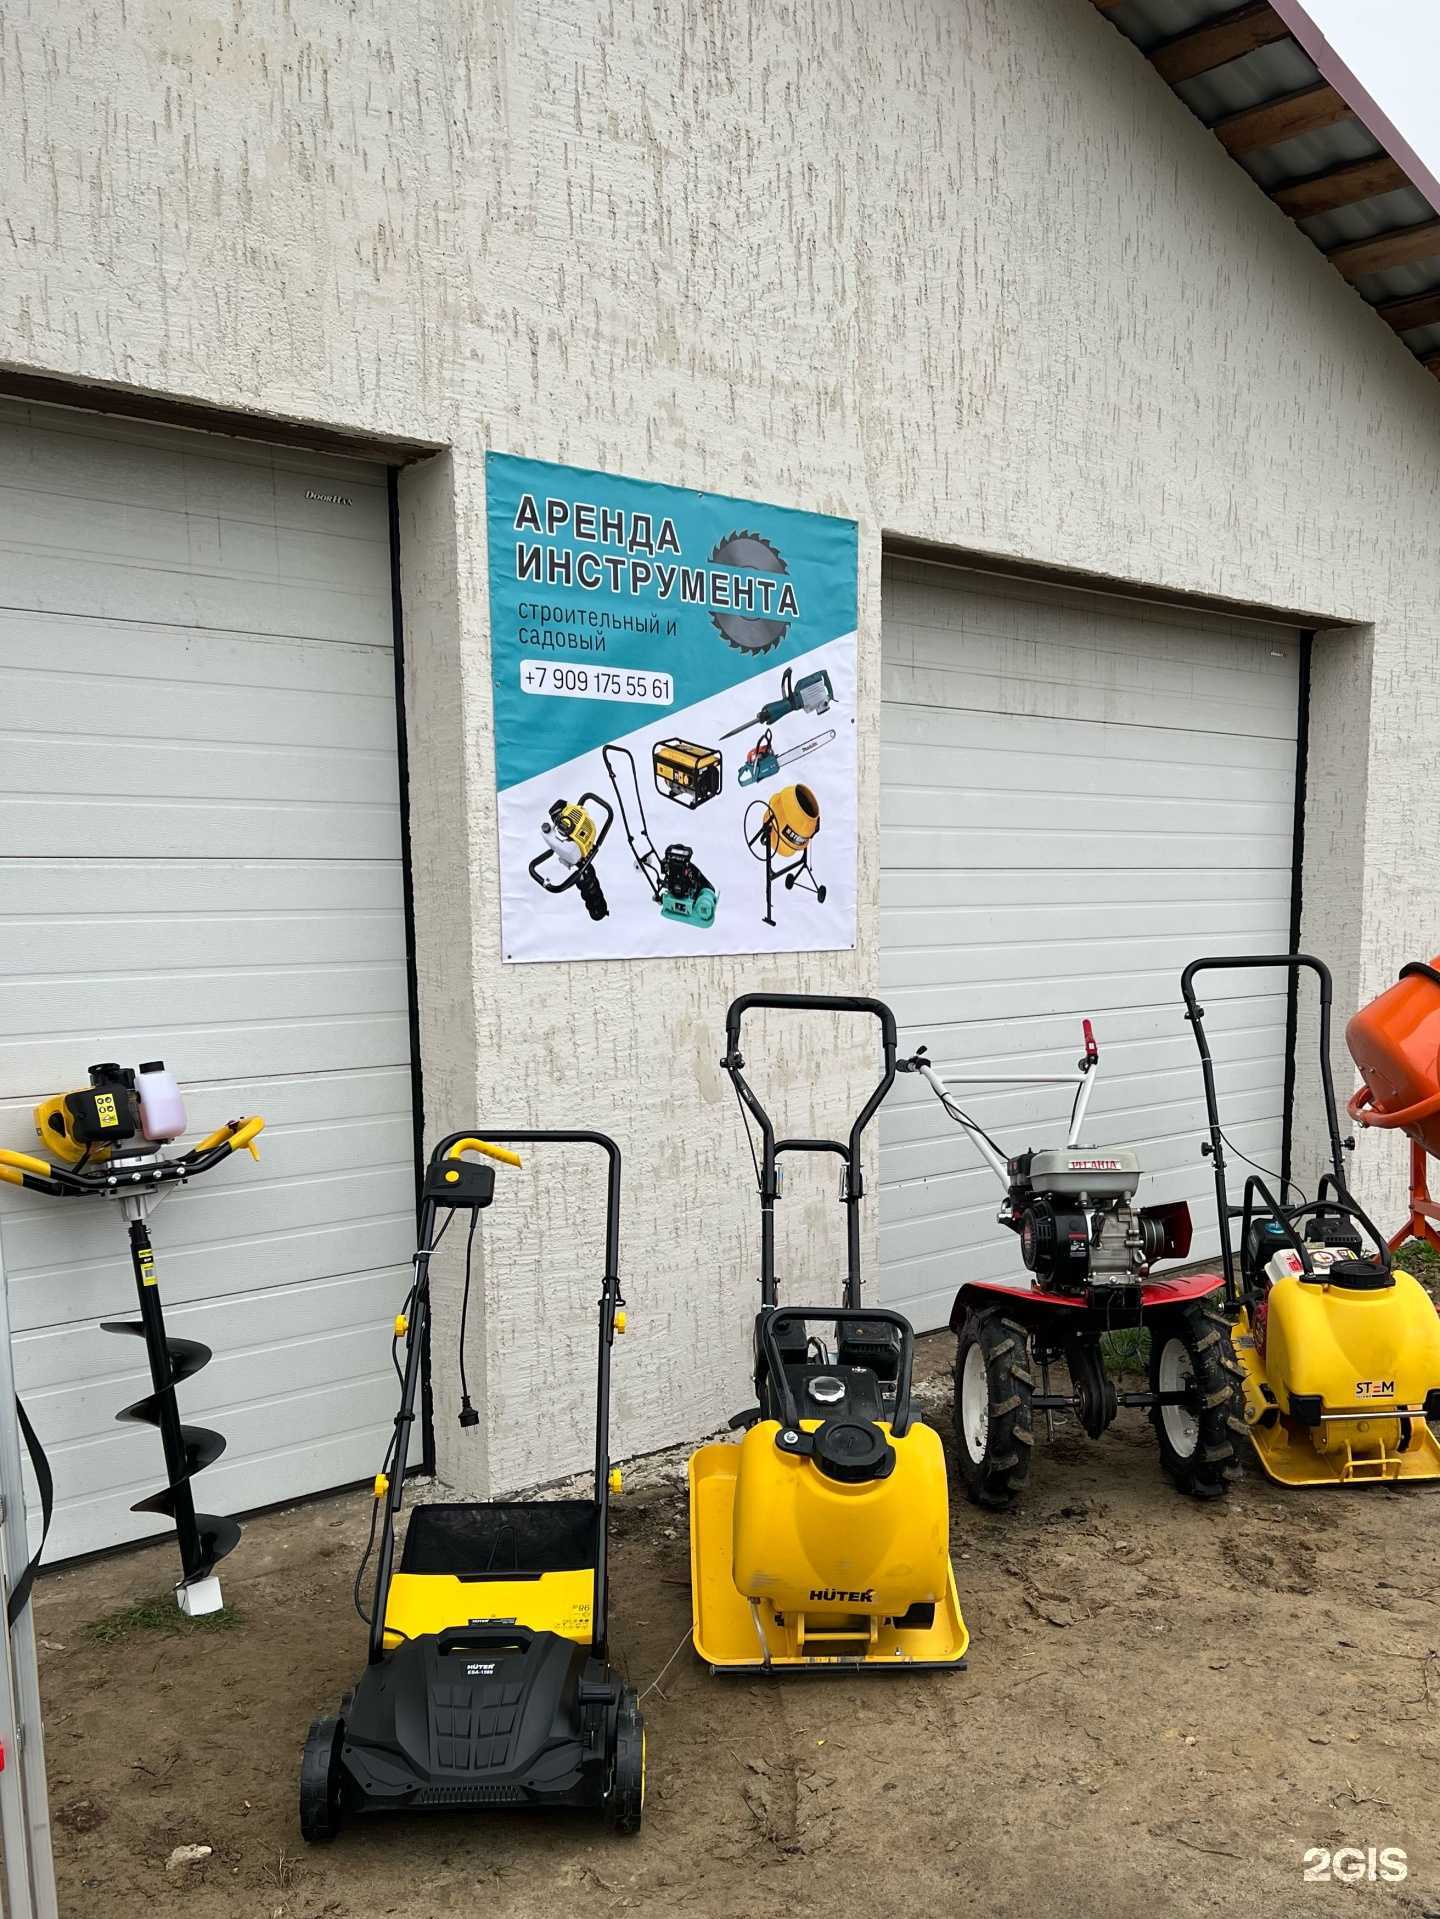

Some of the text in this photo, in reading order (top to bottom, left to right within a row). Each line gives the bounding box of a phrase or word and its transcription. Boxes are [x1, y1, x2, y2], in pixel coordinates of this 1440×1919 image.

[514, 494, 681, 556] АРЕНДА
[516, 542, 800, 617] ИНСТРУМЕНТА
[518, 602, 678, 637] строительный и
[518, 627, 607, 651] садовый
[525, 667, 669, 700] +7 909 175 55 61
[809, 1588, 875, 1603] HÜTER
